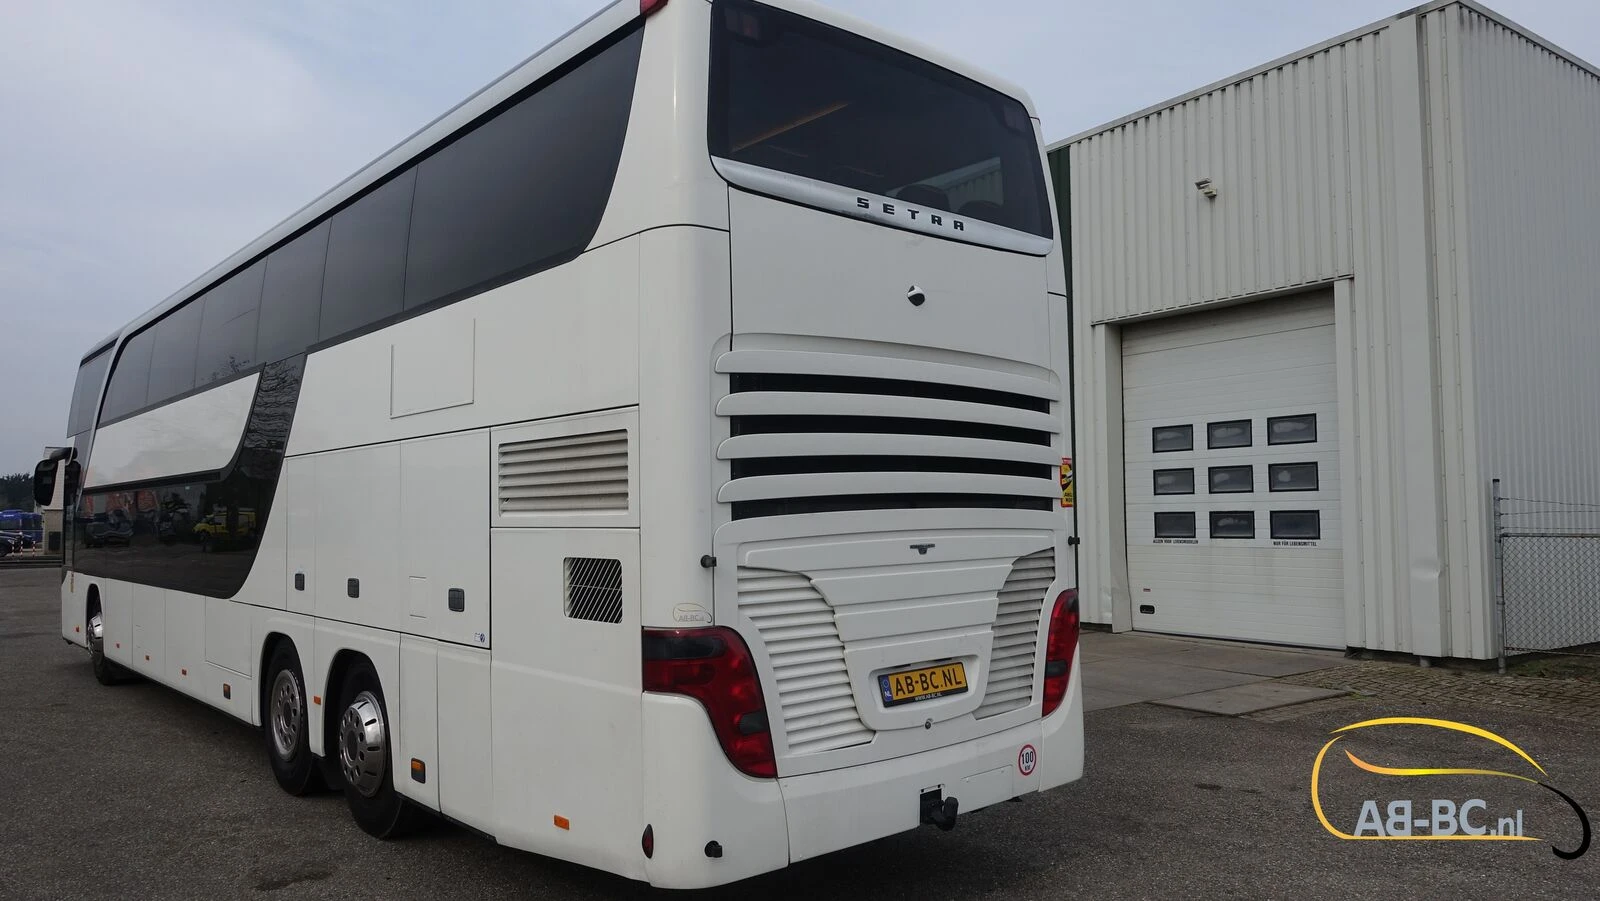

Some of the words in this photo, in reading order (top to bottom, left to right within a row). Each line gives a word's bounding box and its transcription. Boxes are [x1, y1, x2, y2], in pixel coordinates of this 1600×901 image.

[857, 197, 964, 231] SETRA
[895, 668, 963, 696] AB-BC.NL
[884, 690, 892, 698] NL
[1022, 751, 1033, 764] 100
